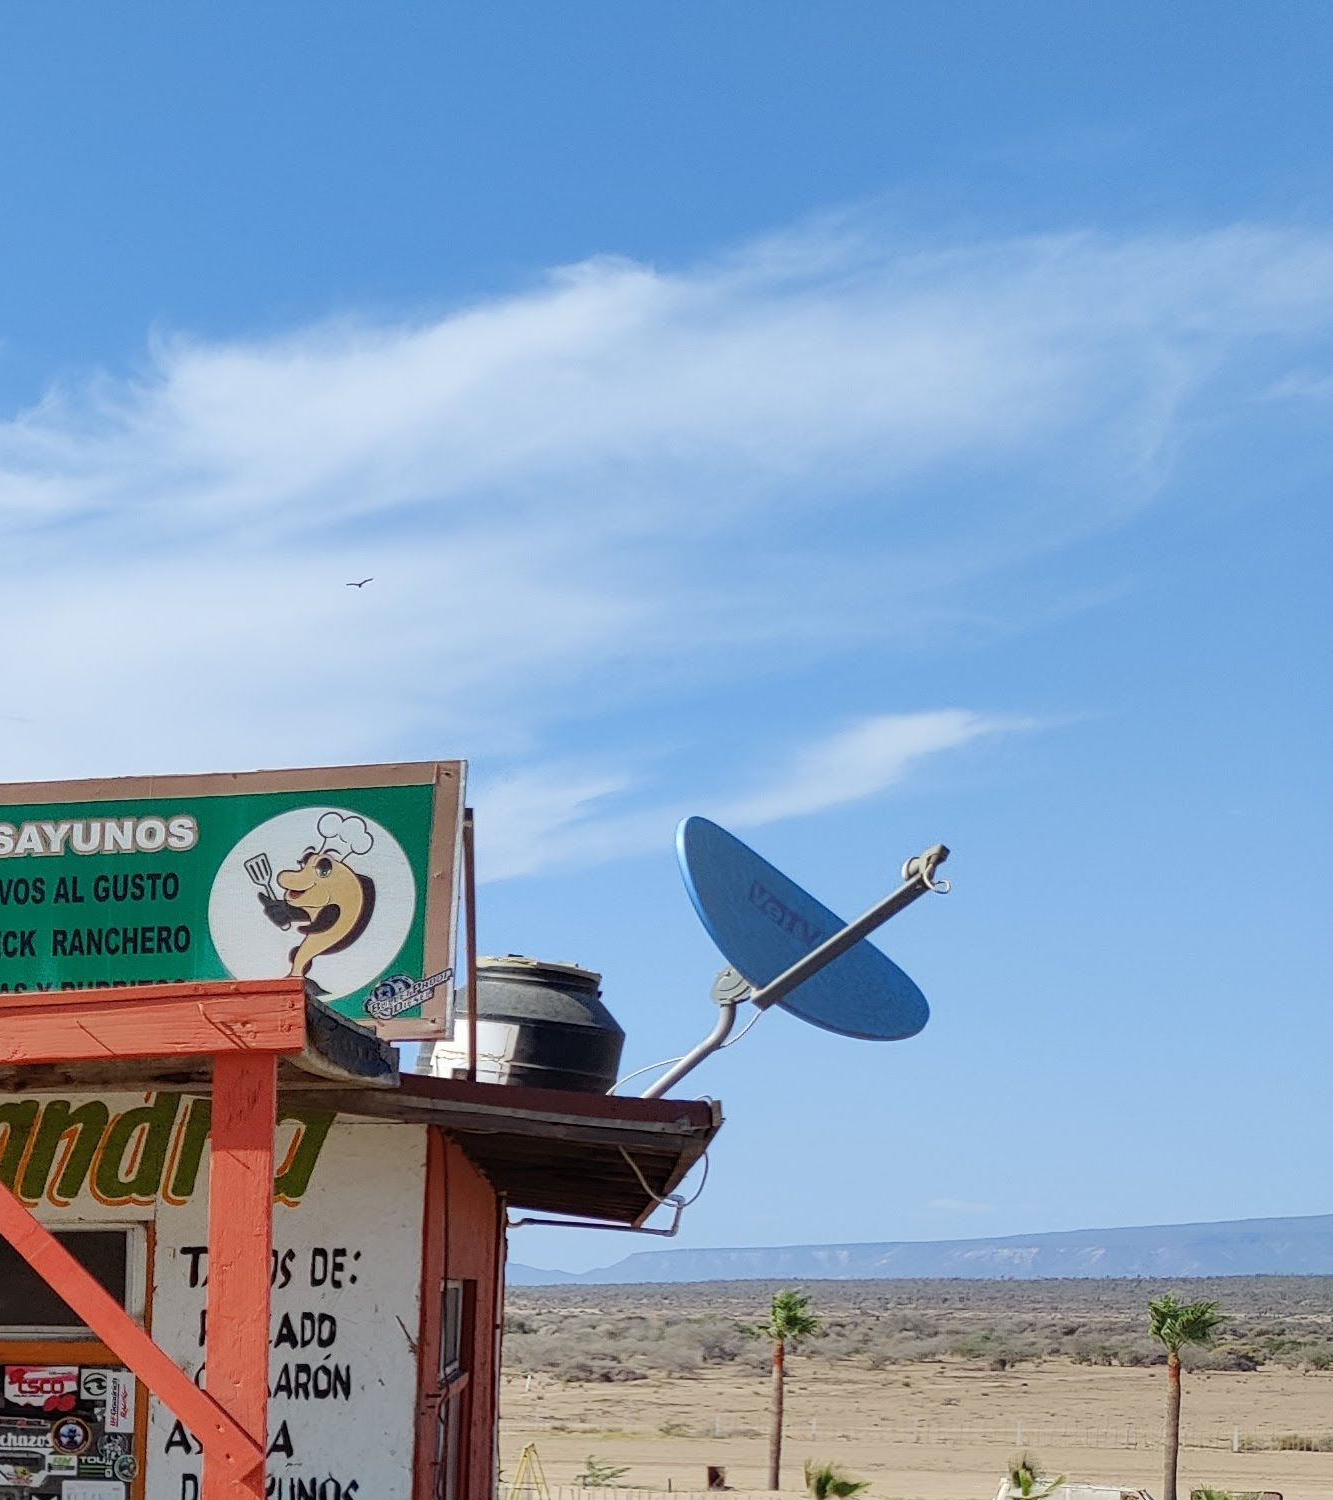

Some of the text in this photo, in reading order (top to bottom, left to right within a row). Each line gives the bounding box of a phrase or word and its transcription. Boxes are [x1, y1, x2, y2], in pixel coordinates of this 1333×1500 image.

[53, 876, 85, 903] AL
[93, 872, 180, 903] GUSTO
[51, 924, 192, 955] RANCHERO
[310, 1248, 362, 1290] DE:
